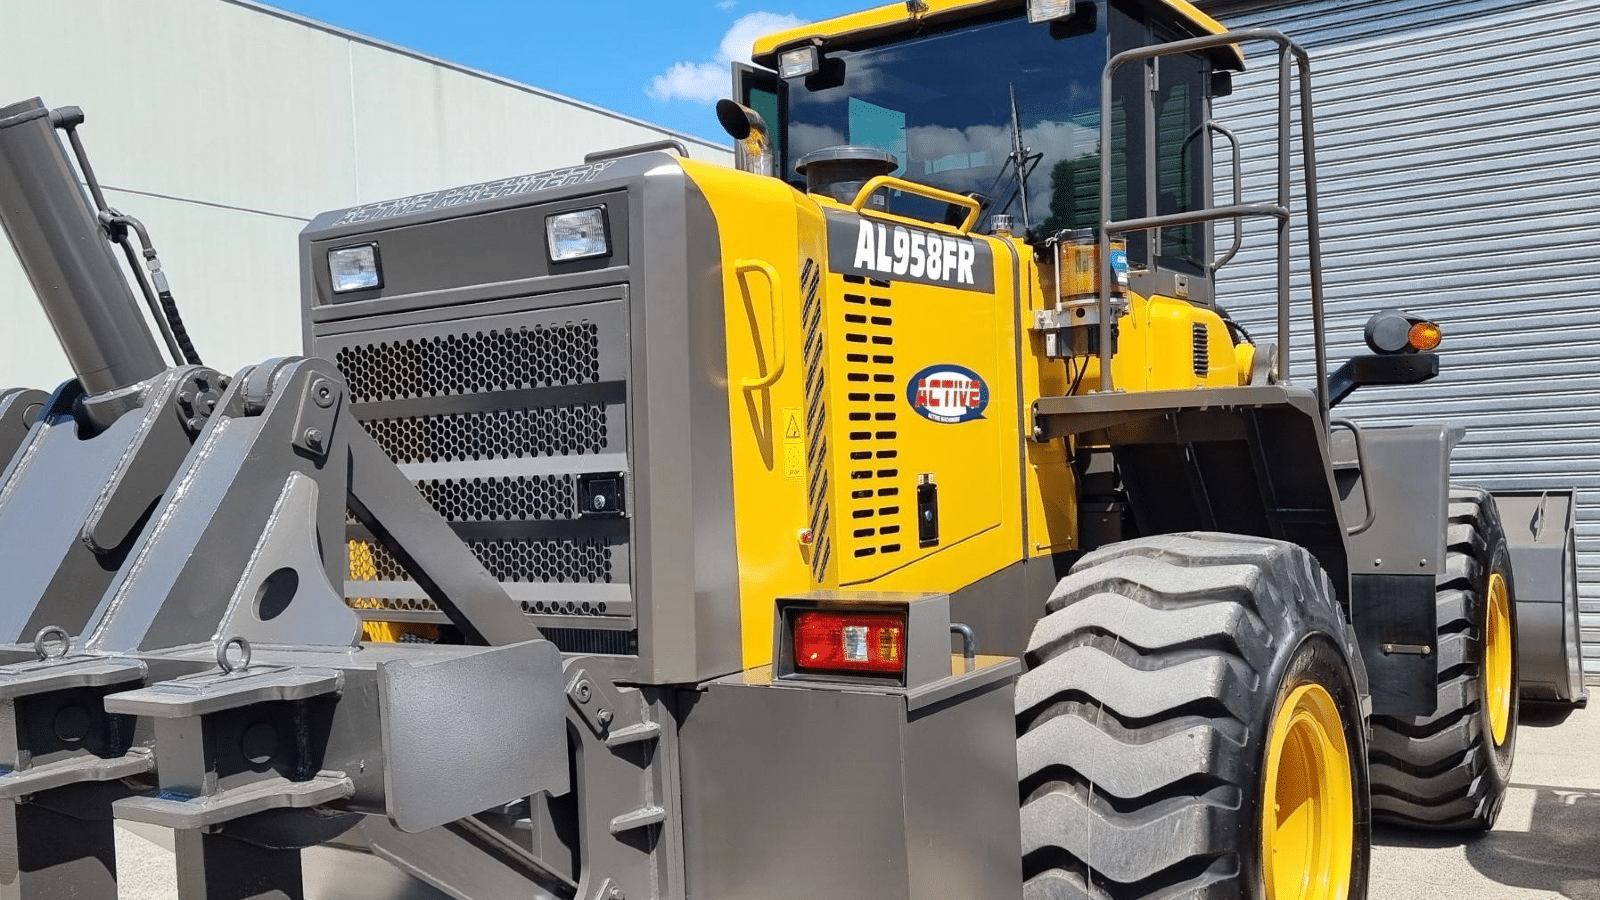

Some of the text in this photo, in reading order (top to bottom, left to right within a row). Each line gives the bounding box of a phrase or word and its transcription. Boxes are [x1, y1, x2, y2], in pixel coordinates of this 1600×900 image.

[333, 161, 615, 226] ACTIVE MACHINERY
[853, 219, 975, 284] AL958FR
[914, 378, 981, 408] ACTIVE
